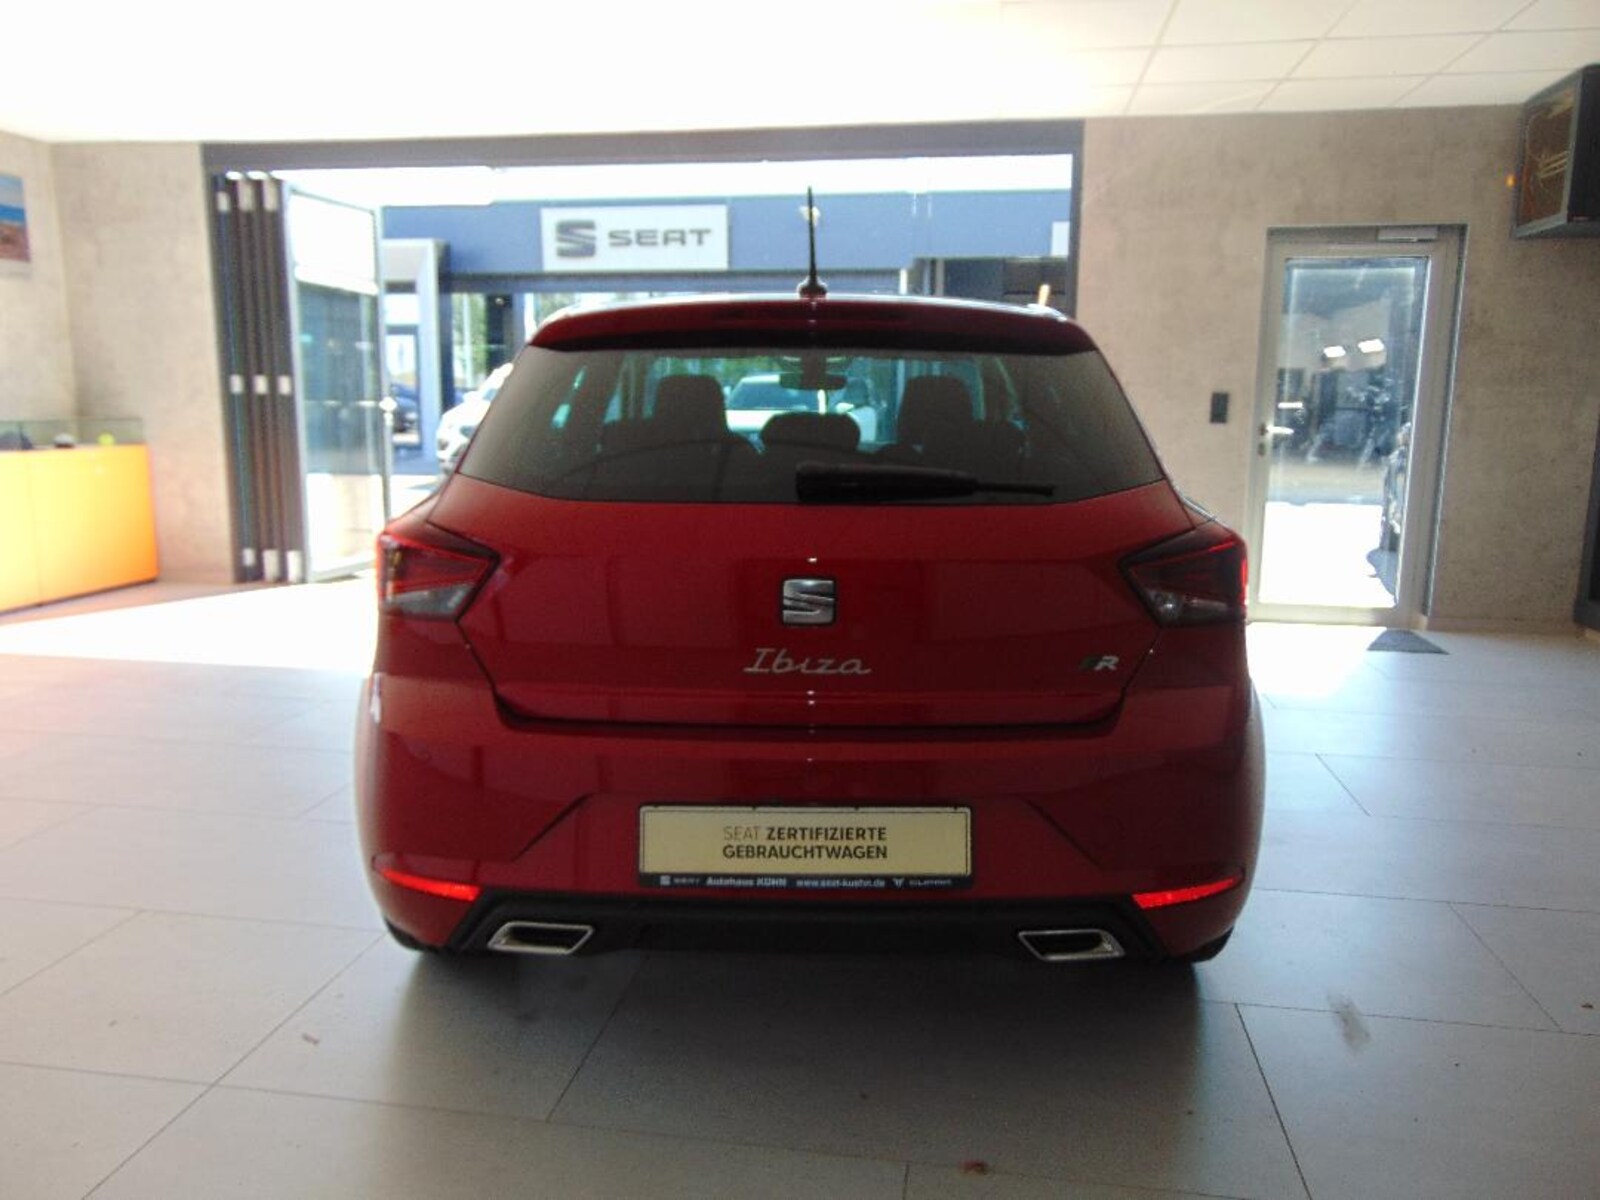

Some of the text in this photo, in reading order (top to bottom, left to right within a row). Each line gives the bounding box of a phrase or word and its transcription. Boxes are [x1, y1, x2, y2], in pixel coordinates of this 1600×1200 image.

[608, 229, 711, 247] SEAT
[744, 646, 872, 675] Ibiza
[723, 826, 887, 841] SEAT ZERTIFIZIERTE
[722, 844, 888, 860] GEBRAUCHTWAGEN
[706, 877, 754, 888] Autohaus
